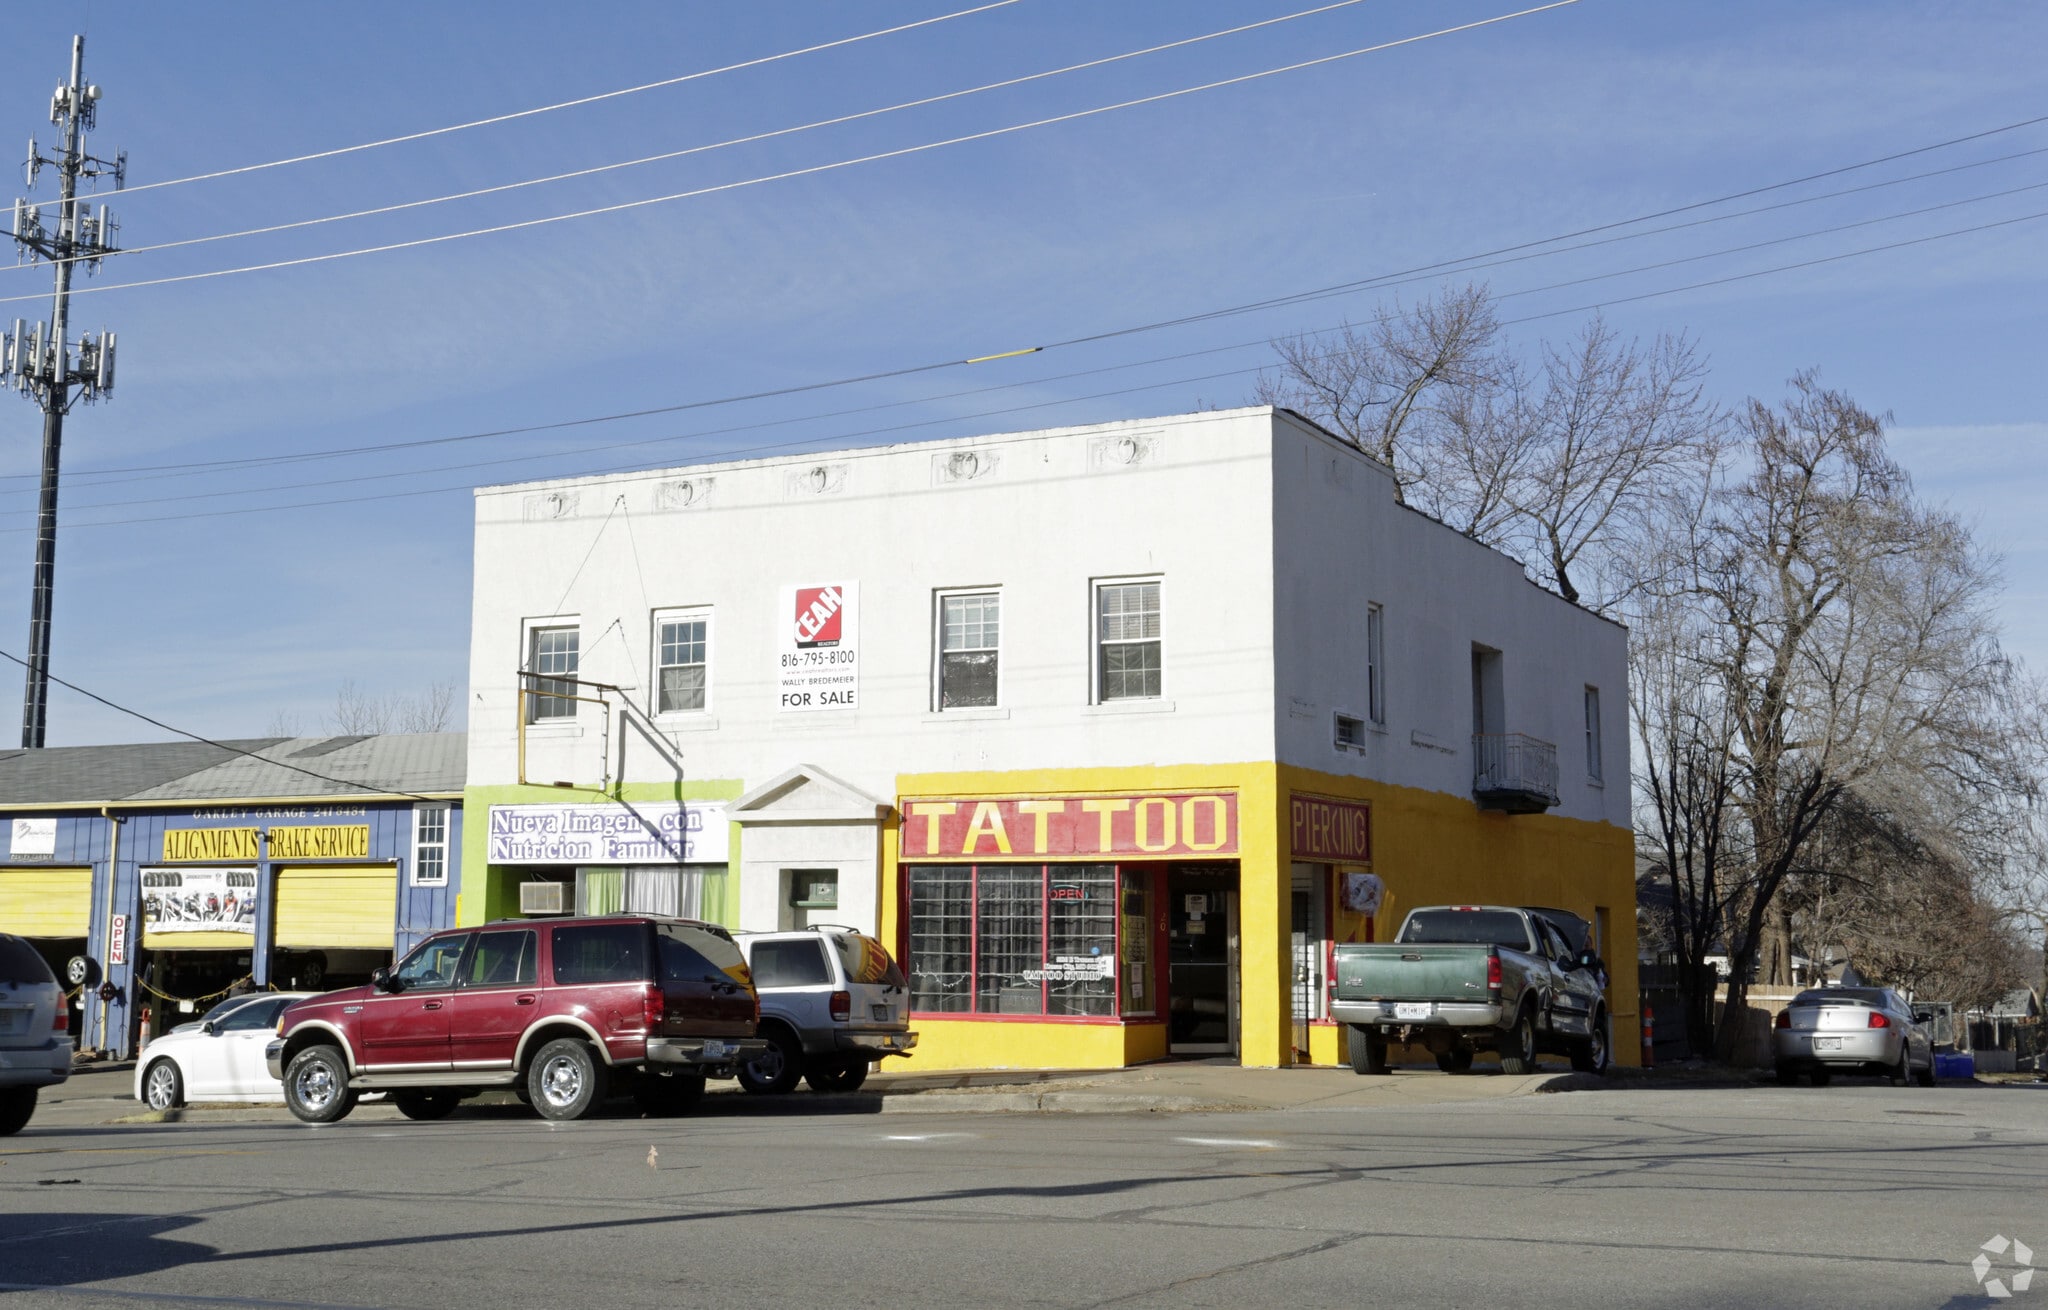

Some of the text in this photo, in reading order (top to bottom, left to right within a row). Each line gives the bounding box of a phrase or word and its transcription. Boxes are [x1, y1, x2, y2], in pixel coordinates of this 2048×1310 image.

[794, 586, 842, 643] CEAH
[781, 649, 855, 667] 816-795-8100
[781, 676, 855, 686] WALLY BREDEMEIER
[782, 690, 855, 707] FOR SALE
[193, 807, 249, 819] OAKLEY
[255, 806, 306, 818] GARAGE
[492, 809, 703, 837] Nueva Imagen con
[912, 795, 1227, 854] TATTOO
[268, 826, 368, 858] BRAKE SERVICE
[1293, 801, 1366, 855] PIERCING
[164, 829, 258, 860] ALIGNMENTS
[491, 835, 694, 860] Nutricion Familiar
[1050, 888, 1083, 900] OPEN
[112, 917, 124, 962] OPEN
